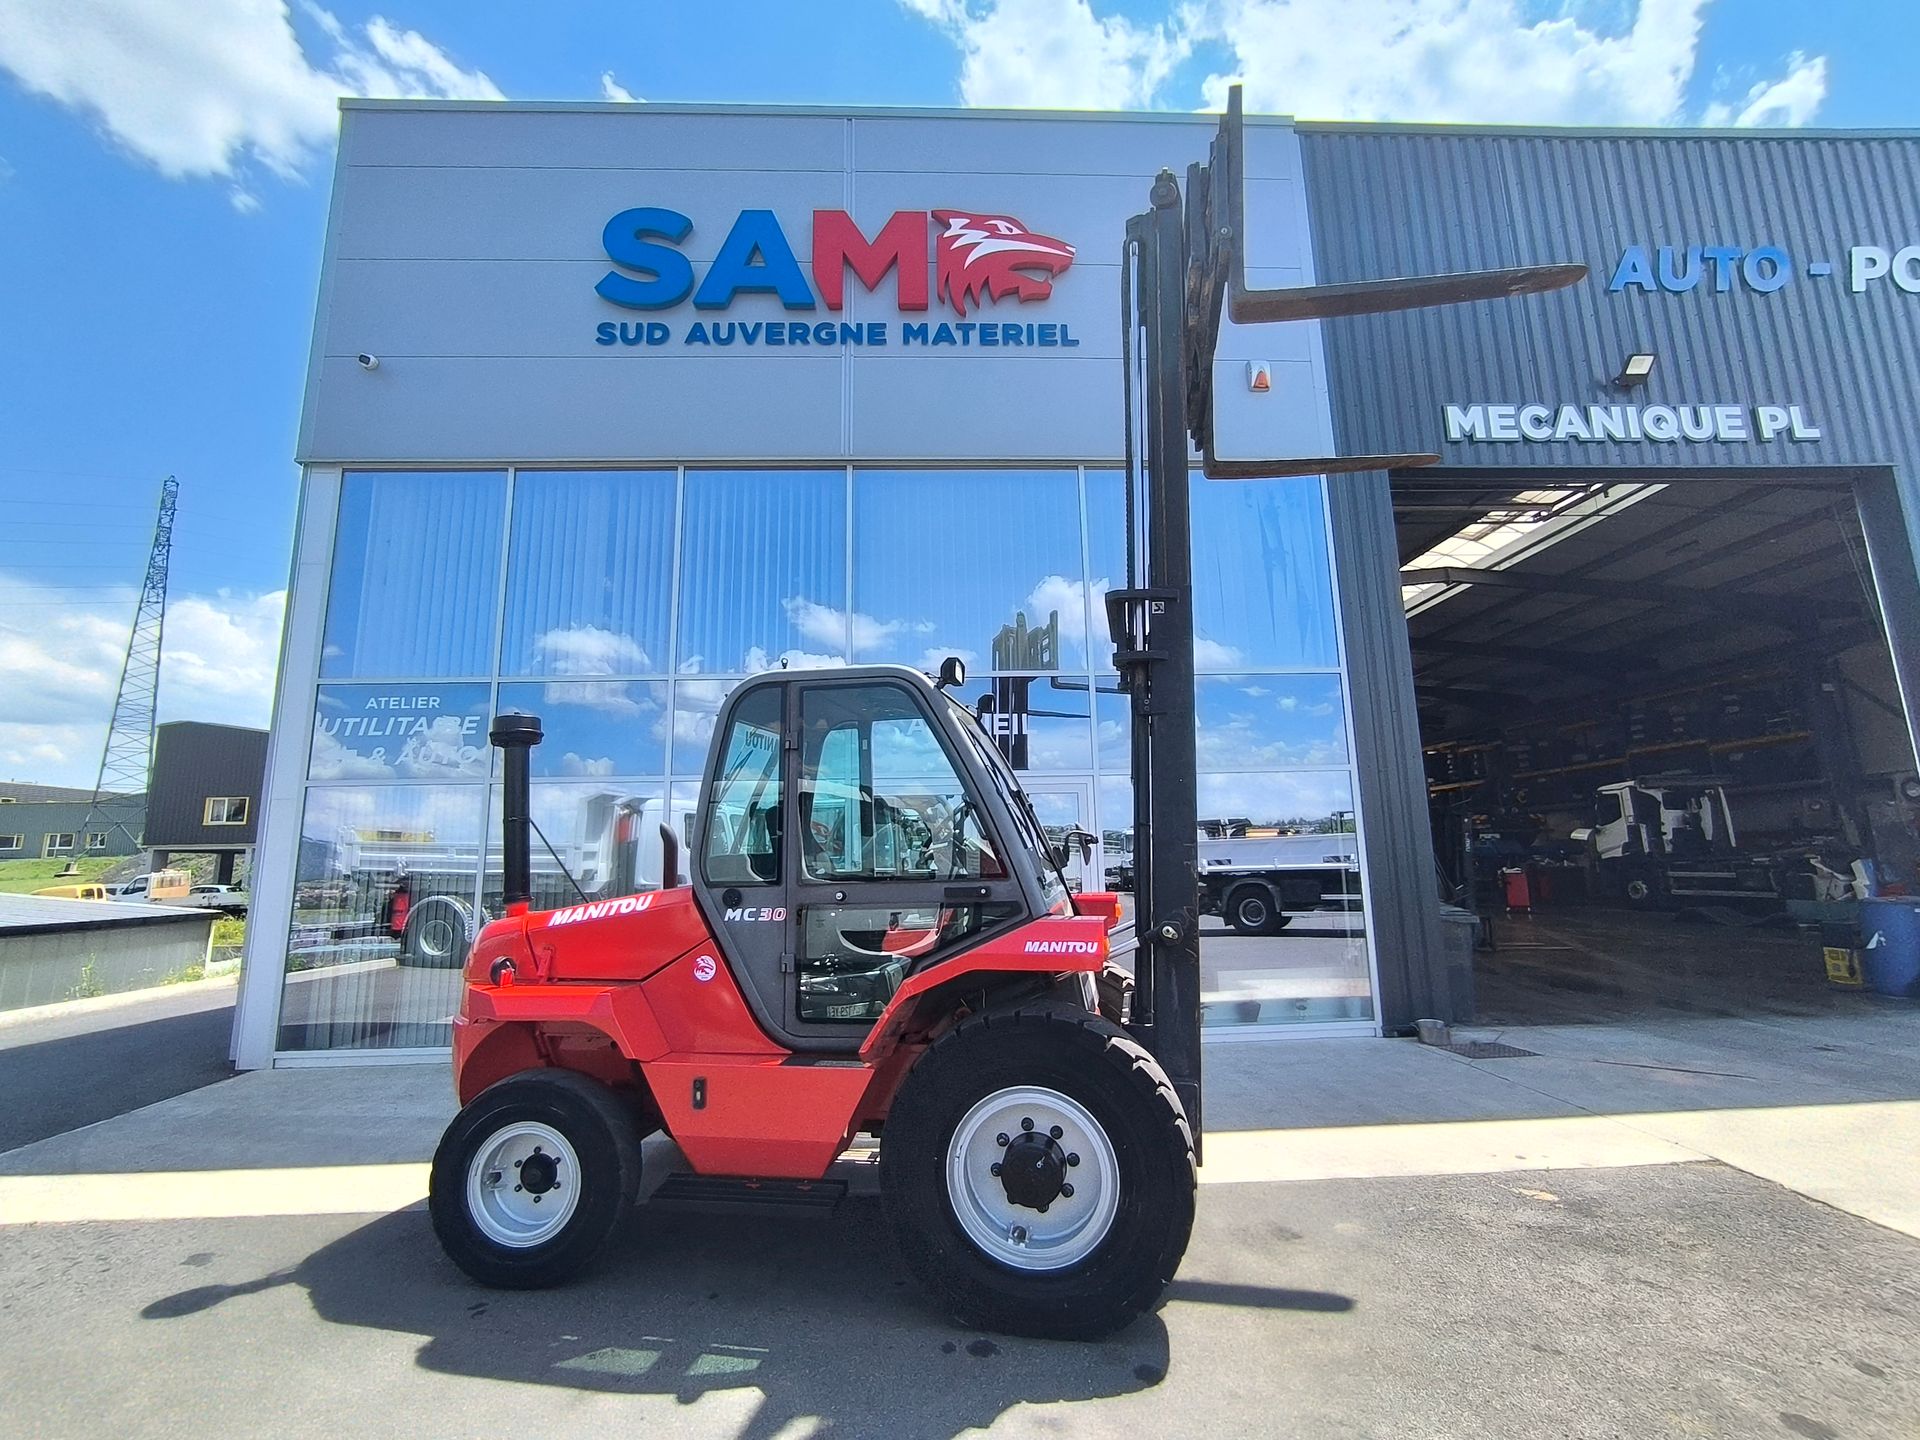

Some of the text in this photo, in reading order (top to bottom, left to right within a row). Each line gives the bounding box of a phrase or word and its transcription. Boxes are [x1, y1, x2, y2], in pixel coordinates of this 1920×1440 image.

[594, 207, 928, 311] SAM
[1609, 246, 1791, 293] AUTO
[595, 322, 1080, 347] SUD AUVERGNE MATERIEL
[1443, 403, 1821, 442] MECANIQUE PL
[365, 696, 441, 710] ATELIER
[320, 715, 481, 737] UTILITAE
[548, 895, 654, 927] MANITOU
[1024, 940, 1099, 954] MANITOU
